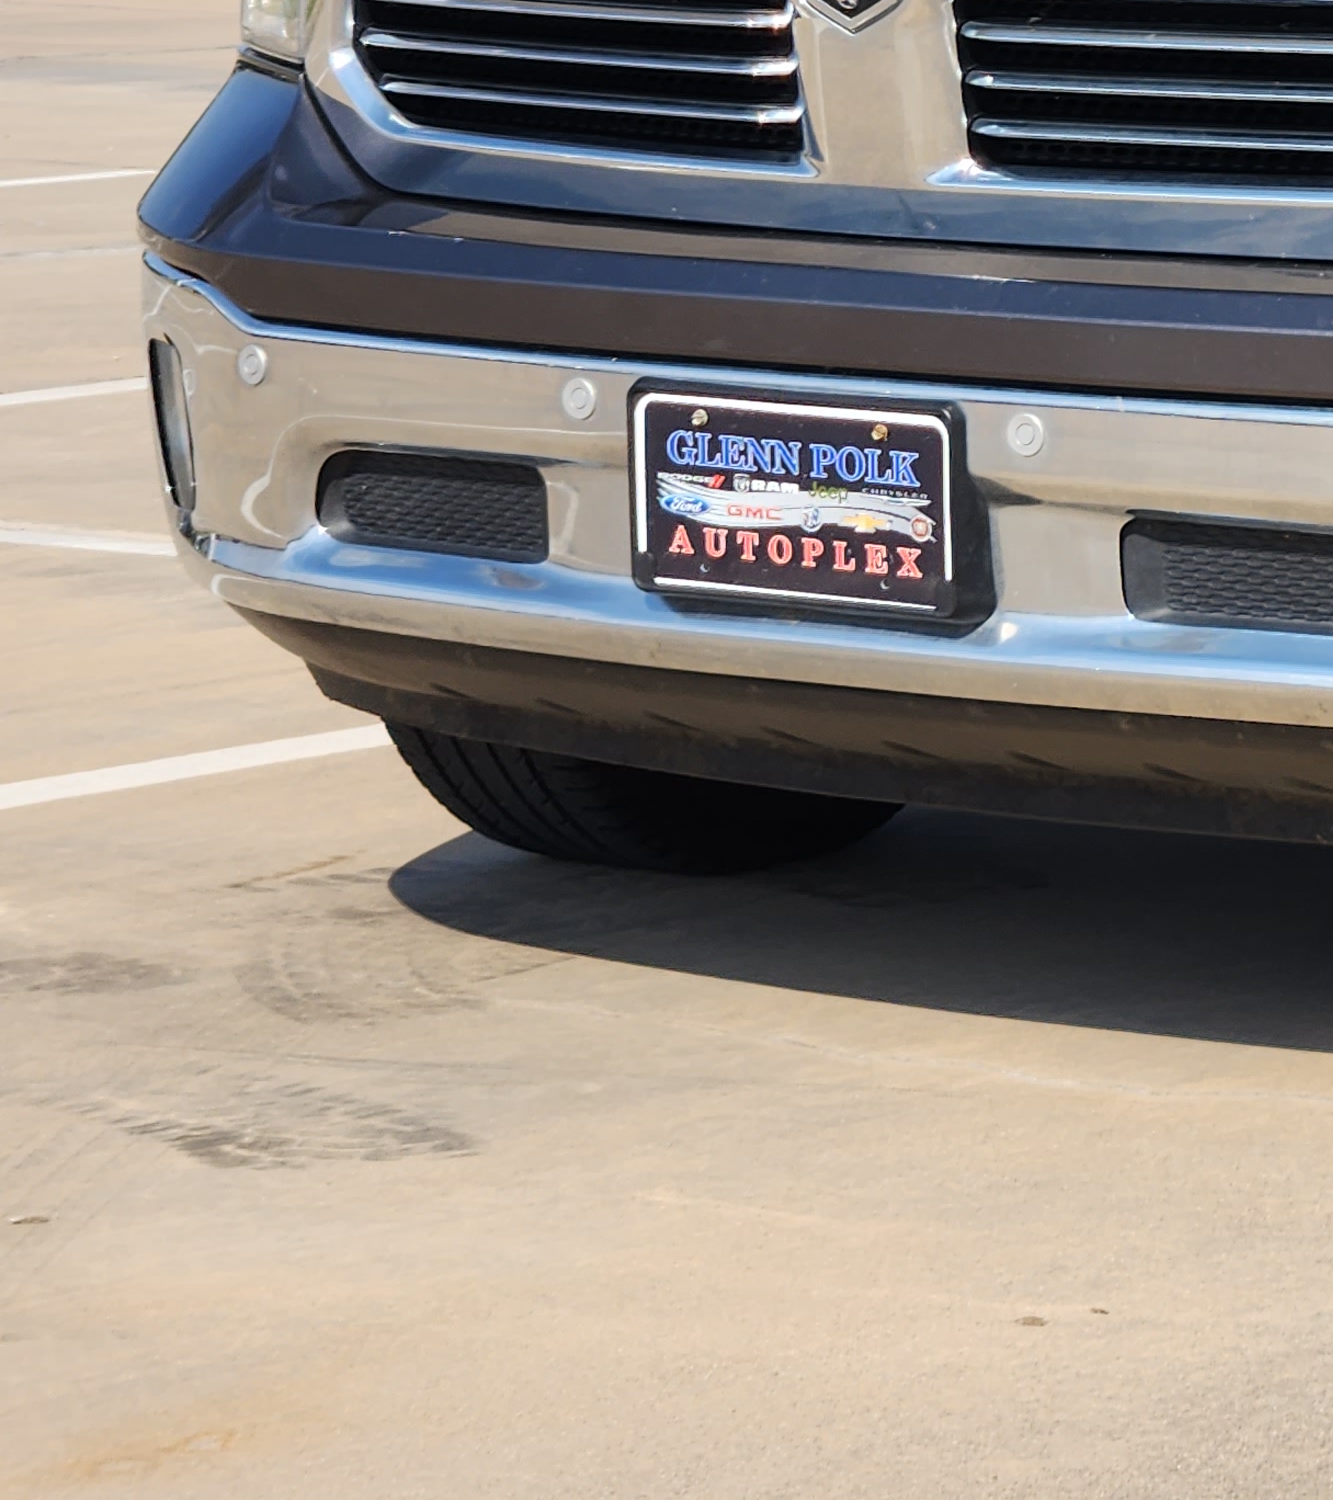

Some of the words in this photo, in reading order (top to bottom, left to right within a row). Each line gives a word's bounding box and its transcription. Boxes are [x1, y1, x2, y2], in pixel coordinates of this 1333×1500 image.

[666, 429, 801, 476] GLENN
[809, 443, 921, 488] POLK
[657, 471, 713, 484] DODGE
[751, 479, 800, 494] RAM
[808, 481, 848, 504] Jeep
[862, 487, 929, 500] CHRYSLER
[669, 495, 703, 514] Ford
[727, 503, 782, 521] GMC
[668, 524, 923, 579] AUTOPLEX
